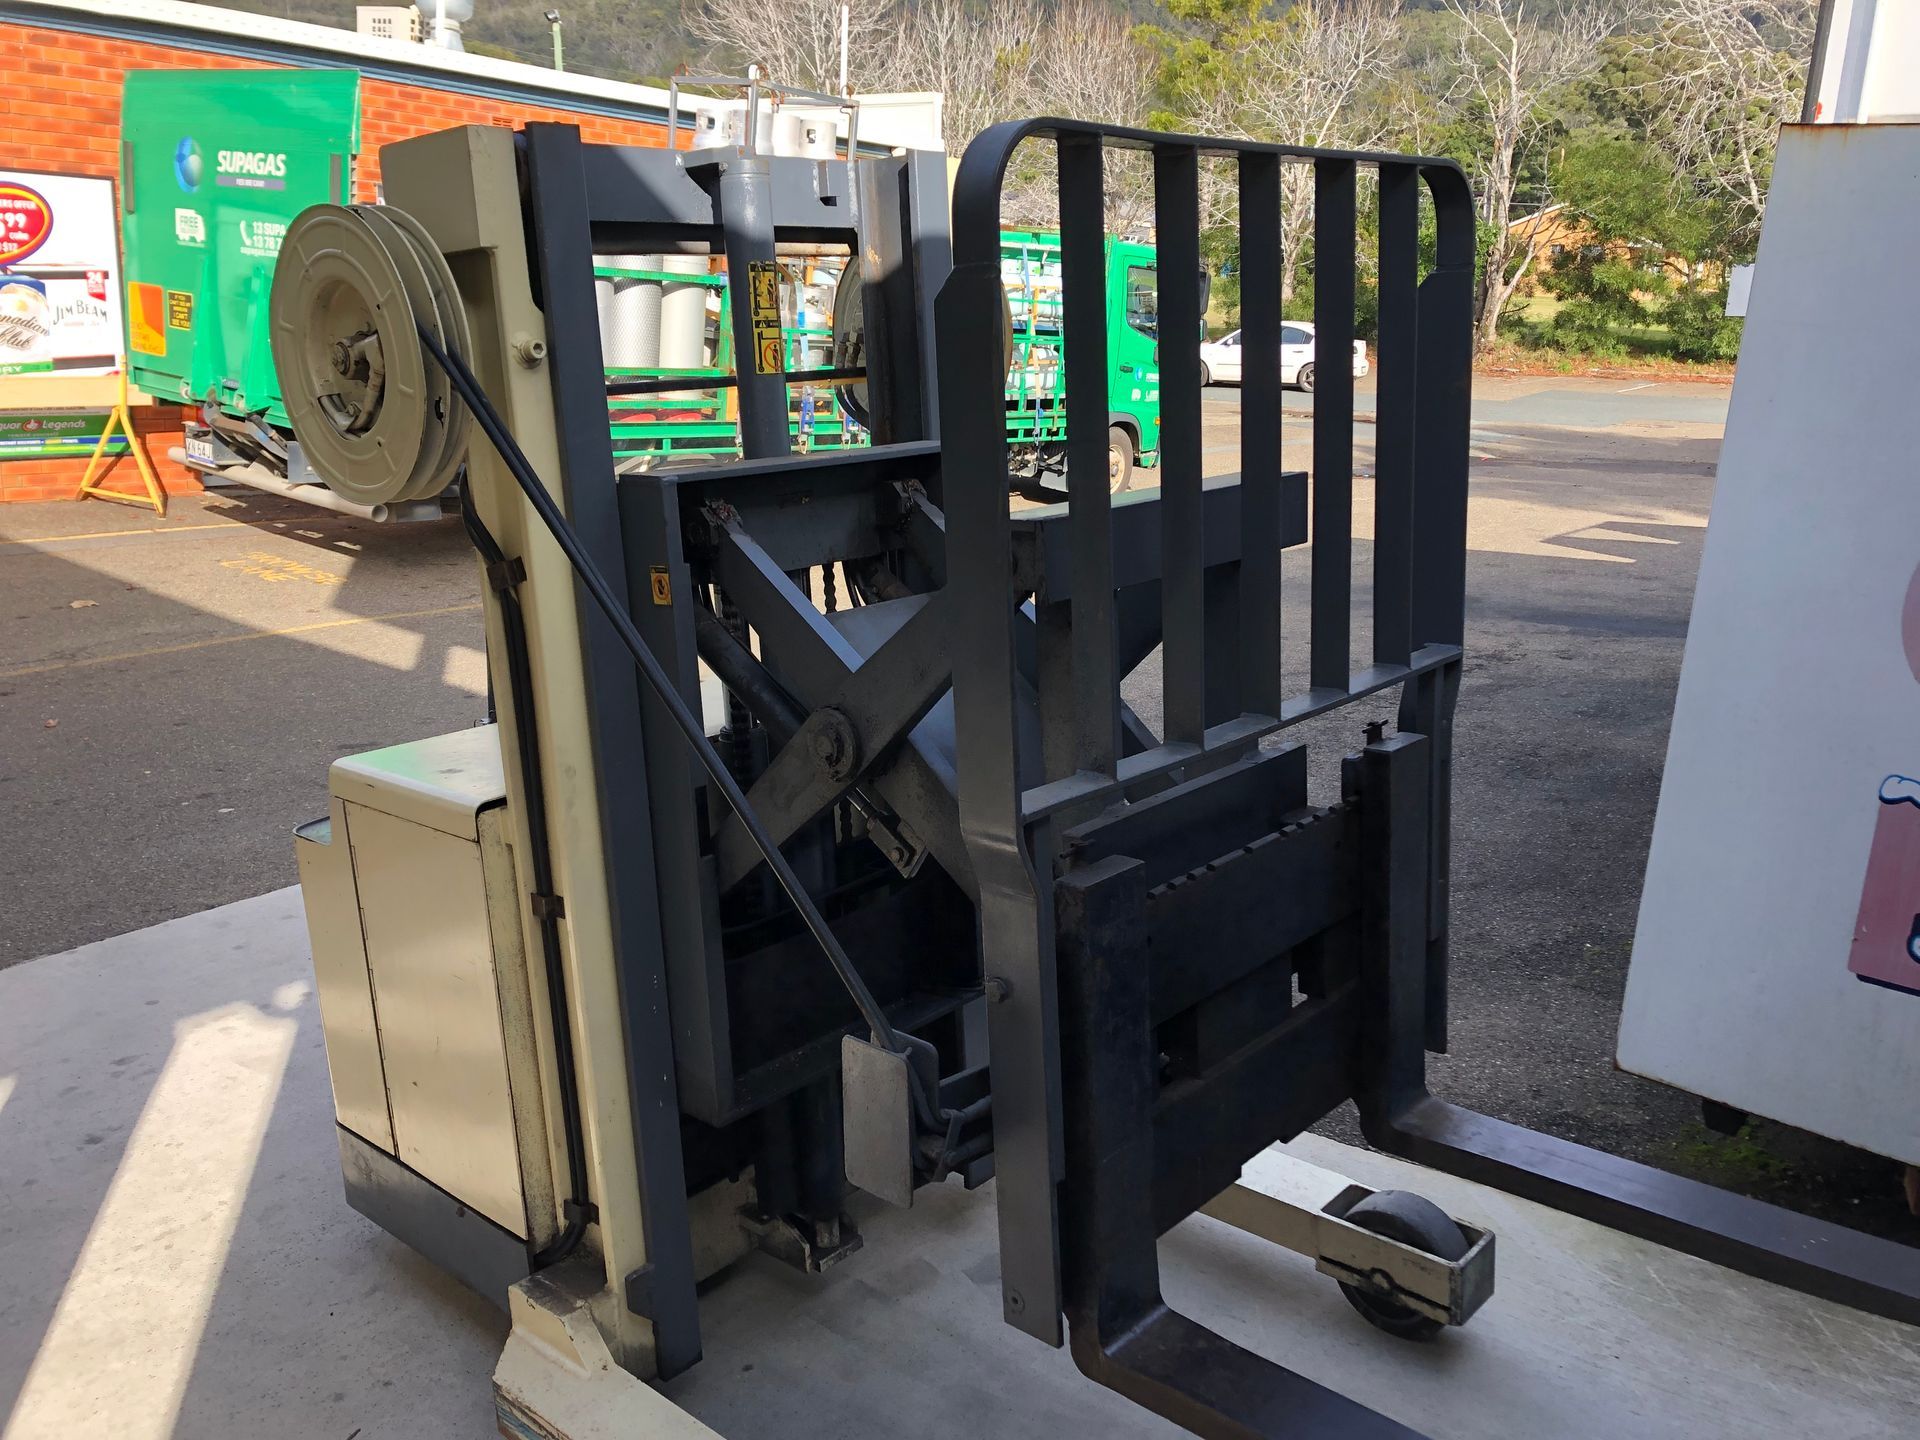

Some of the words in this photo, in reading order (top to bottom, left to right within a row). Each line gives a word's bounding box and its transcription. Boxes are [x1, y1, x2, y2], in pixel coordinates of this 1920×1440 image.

[216, 150, 287, 177] SUPAGAS
[253, 221, 263, 235] 13
[264, 222, 286, 236] SUPA
[252, 234, 263, 248] 13
[86, 270, 103, 282] 24
[53, 304, 74, 326] JIM
[76, 299, 108, 323] BEAM
[42, 419, 86, 431] Legends
